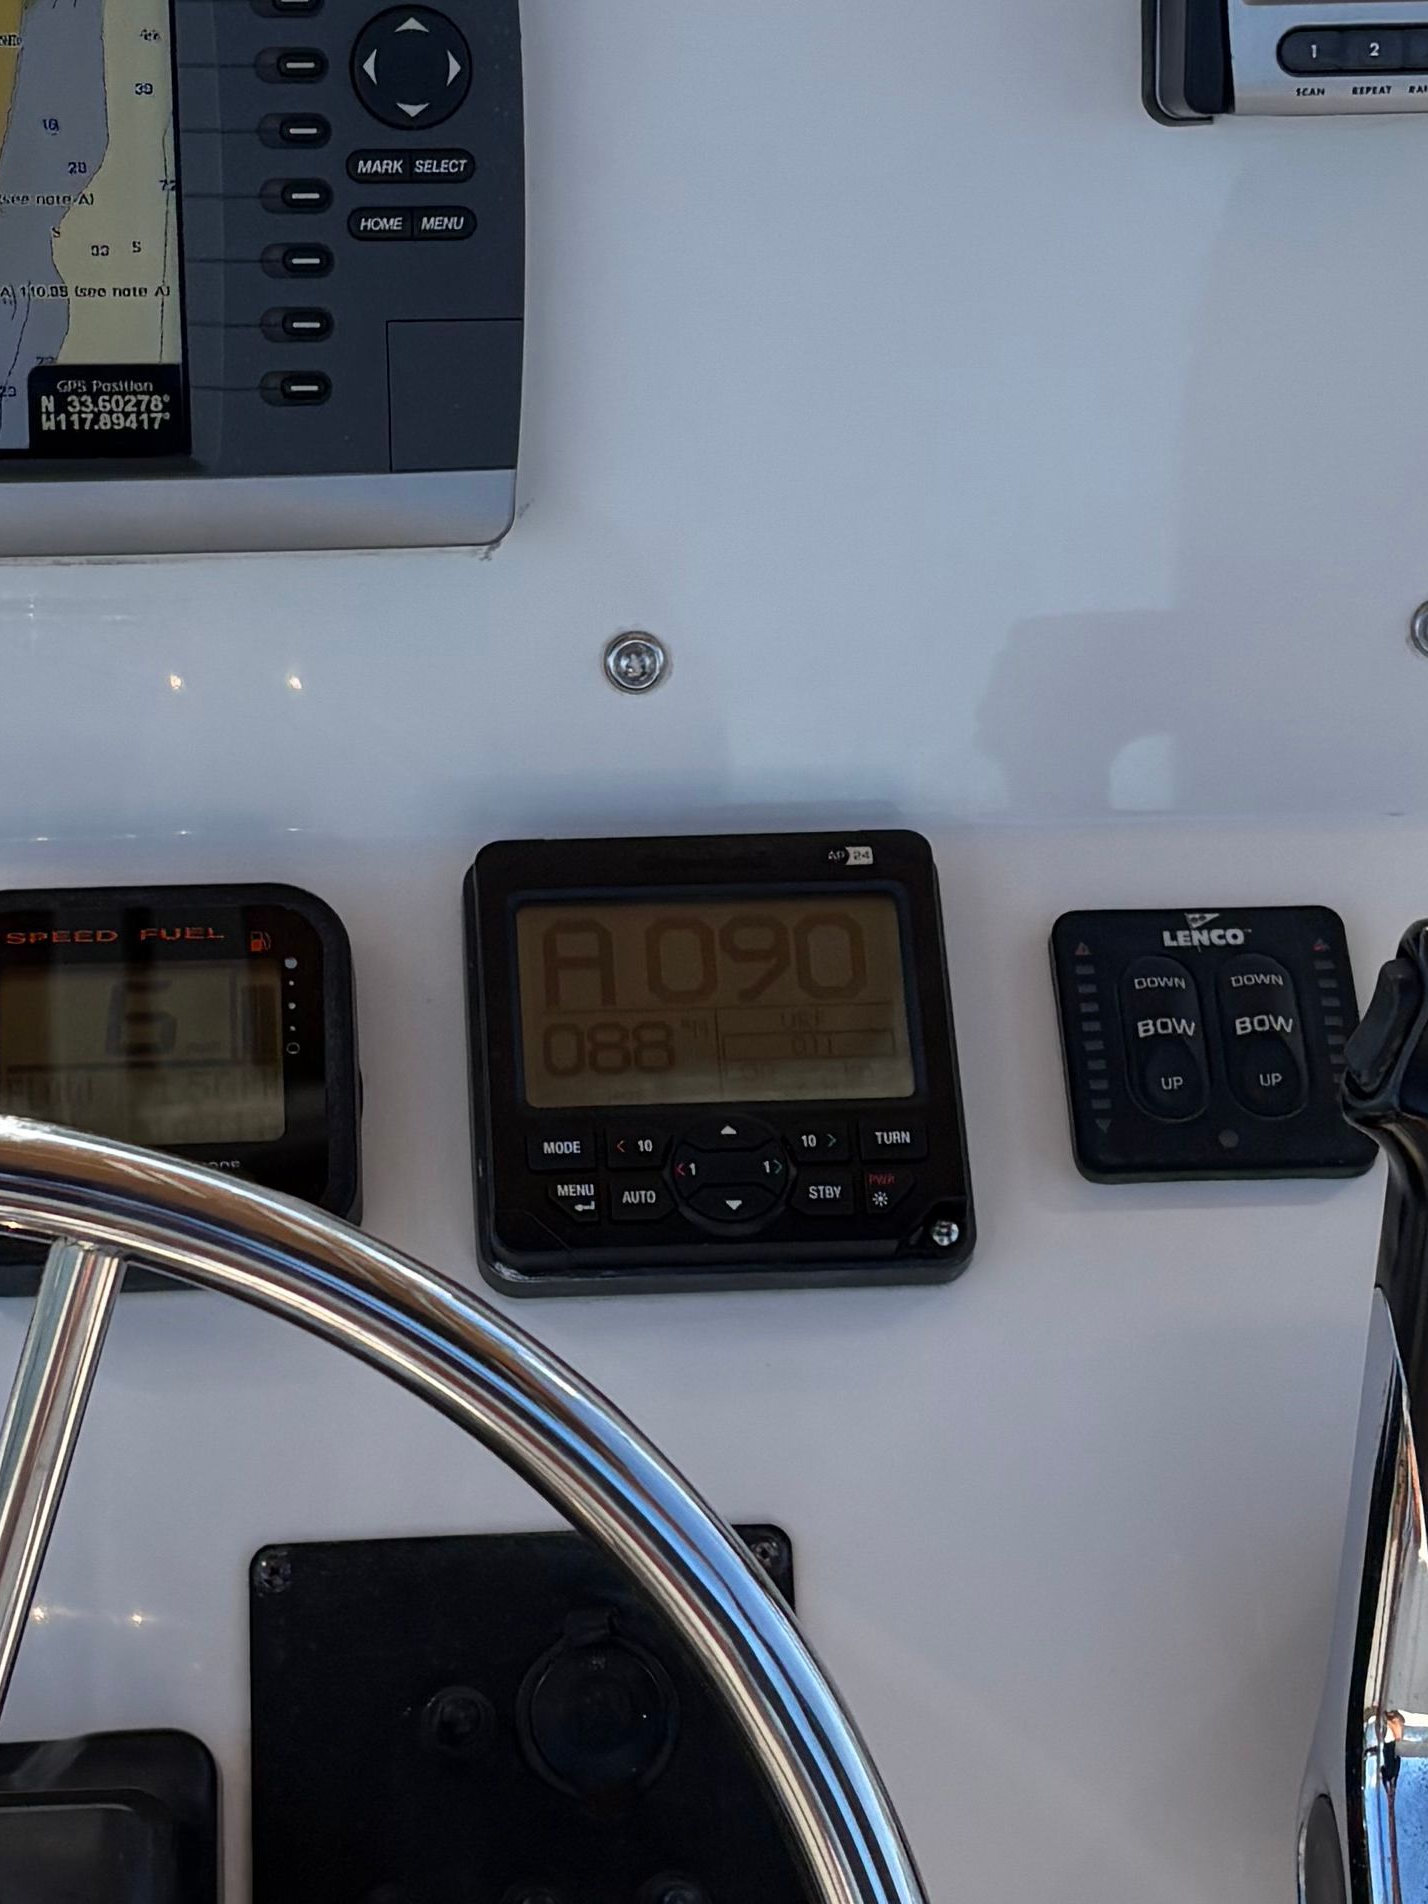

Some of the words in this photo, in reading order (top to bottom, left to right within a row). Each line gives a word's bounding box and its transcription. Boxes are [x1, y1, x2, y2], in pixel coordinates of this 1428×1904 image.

[1309, 43, 1319, 59] 1
[1368, 42, 1380, 58] 2
[357, 158, 404, 174] MARK
[414, 157, 468, 174] SELECT
[359, 216, 403, 231] HOME
[420, 215, 465, 231] MENU
[5, 928, 119, 945] SPEED
[139, 926, 226, 942] FUEL
[1161, 928, 1246, 947] LENCO
[542, 917, 616, 1007] A
[645, 912, 867, 1004] 090
[1134, 975, 1186, 990] DOWN
[1230, 973, 1284, 988] DOWN
[1136, 1017, 1196, 1039] BOW
[1234, 1013, 1294, 1036] BOW
[1160, 1076, 1184, 1091] UP
[1259, 1072, 1283, 1087] UP
[874, 1131, 911, 1146] TURN
[542, 1140, 581, 1155] MODE
[556, 1184, 595, 1198] MENU
[622, 1190, 656, 1205] AUTO
[808, 1185, 842, 1200] STBY
